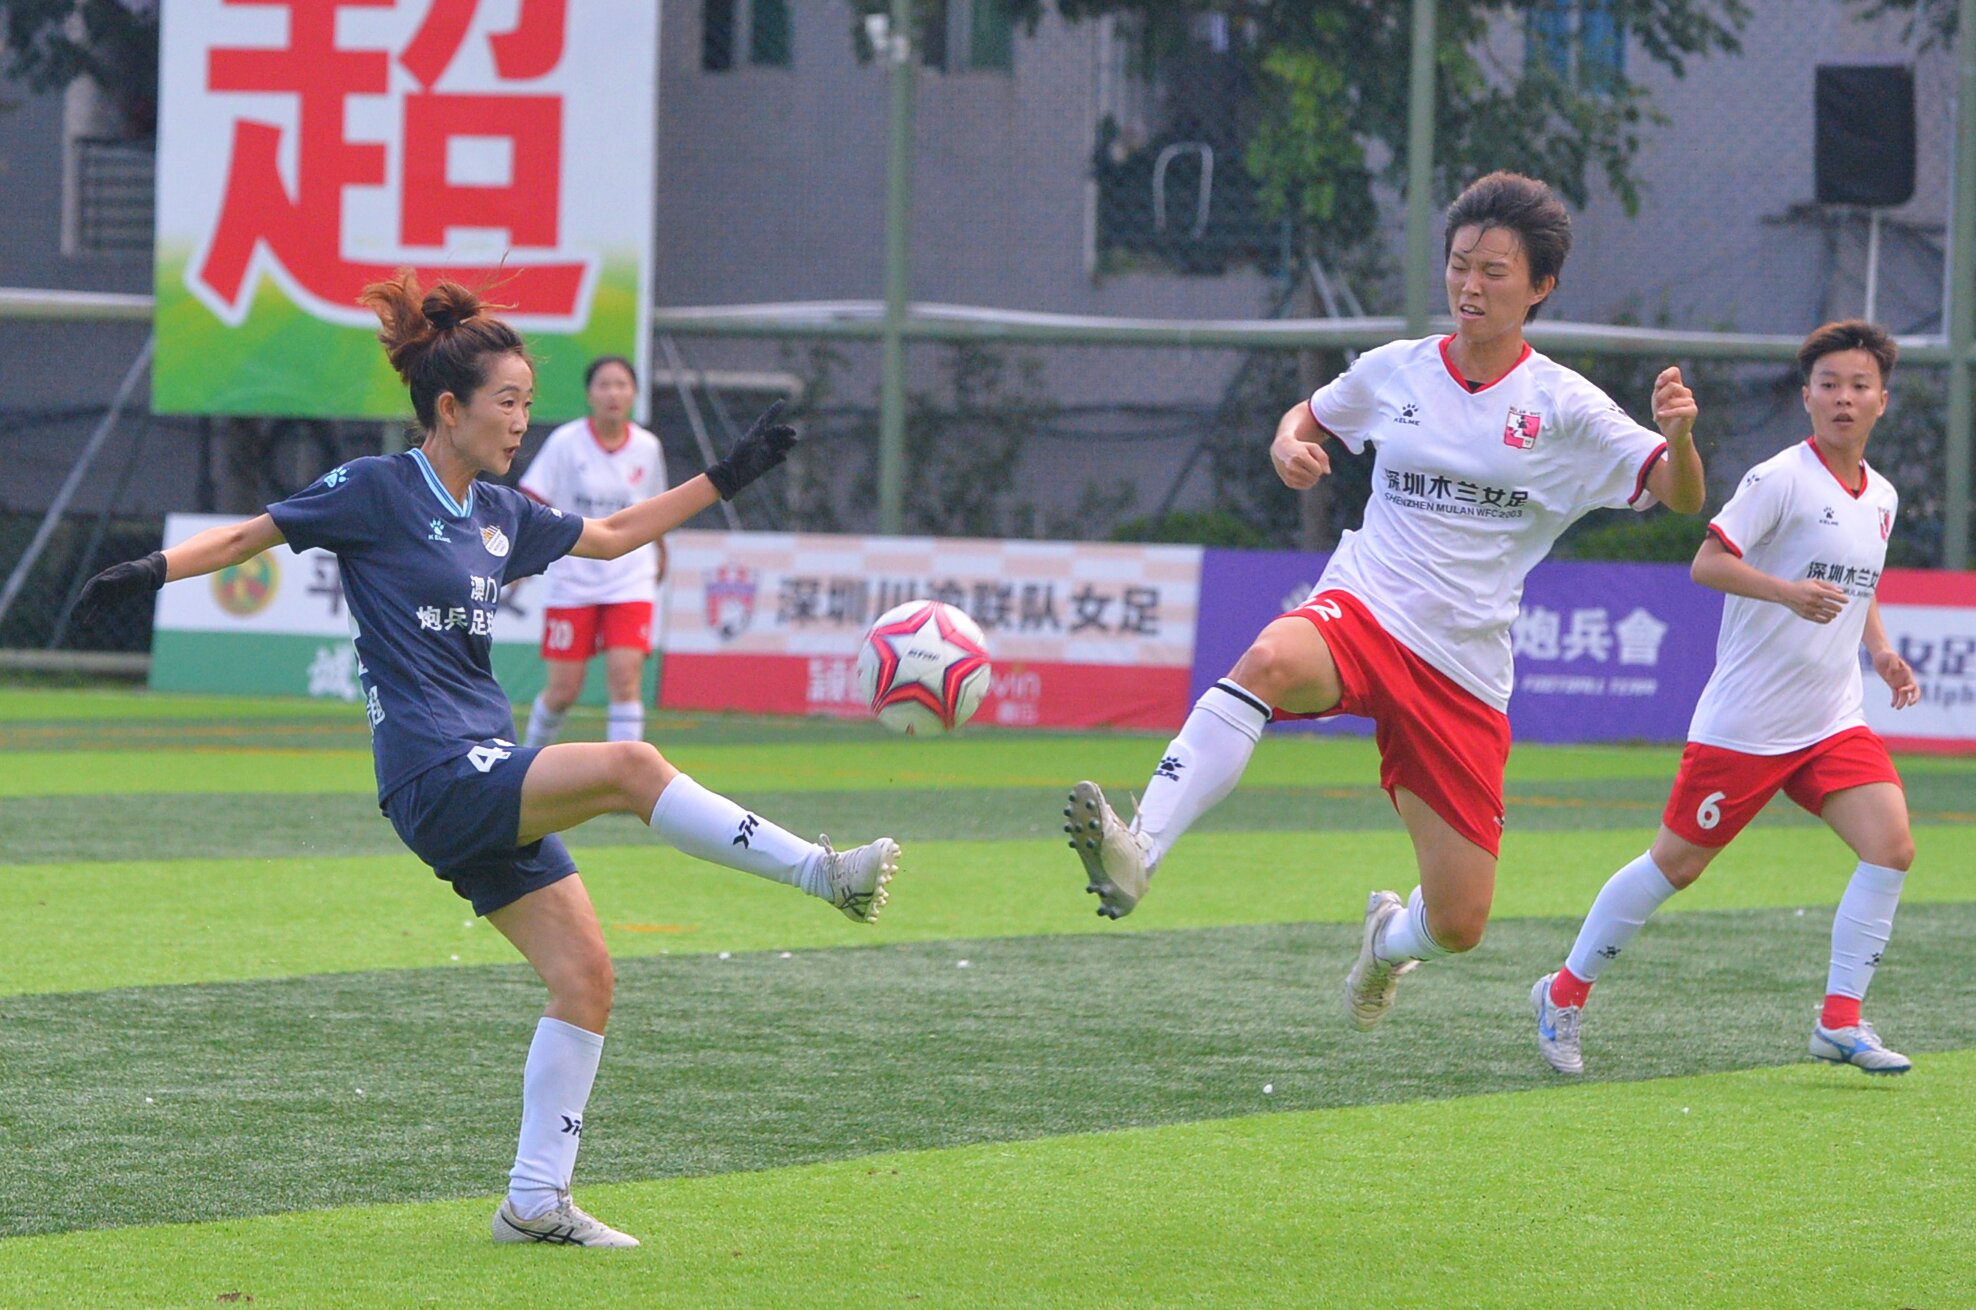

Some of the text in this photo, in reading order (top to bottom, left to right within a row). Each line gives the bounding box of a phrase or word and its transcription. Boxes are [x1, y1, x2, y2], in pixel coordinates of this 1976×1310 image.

[190, 0, 595, 325] 超
[1394, 416, 1420, 427] KELME
[1384, 468, 1528, 508] 深圳木兰女足
[1385, 492, 1434, 511] SHENZHEN
[1436, 504, 1475, 516] MULAN
[1477, 509, 1498, 518] WFC
[470, 575, 498, 604] 澳门
[1696, 790, 1726, 830] 6
